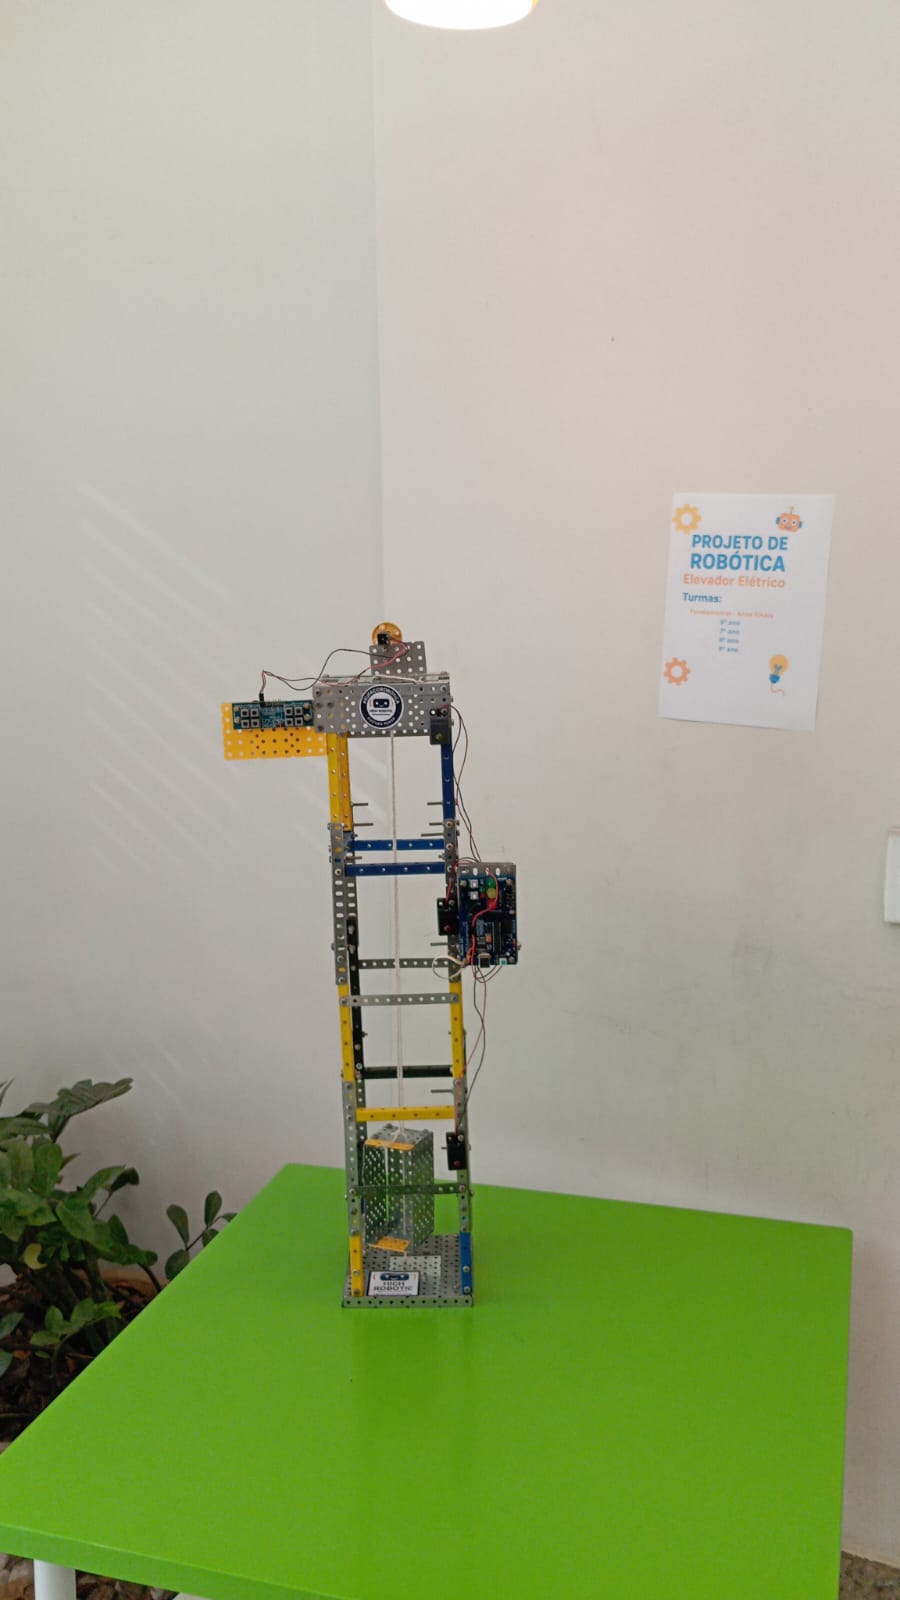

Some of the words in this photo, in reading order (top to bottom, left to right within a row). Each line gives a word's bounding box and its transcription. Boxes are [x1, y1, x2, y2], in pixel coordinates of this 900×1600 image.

[692, 534, 763, 550] PROJETO
[767, 536, 789, 551] DE
[690, 550, 785, 572] ROBÓTICA
[683, 573, 734, 586] Elevador
[738, 575, 785, 588] Elétrico
[682, 592, 722, 603] Turmas:
